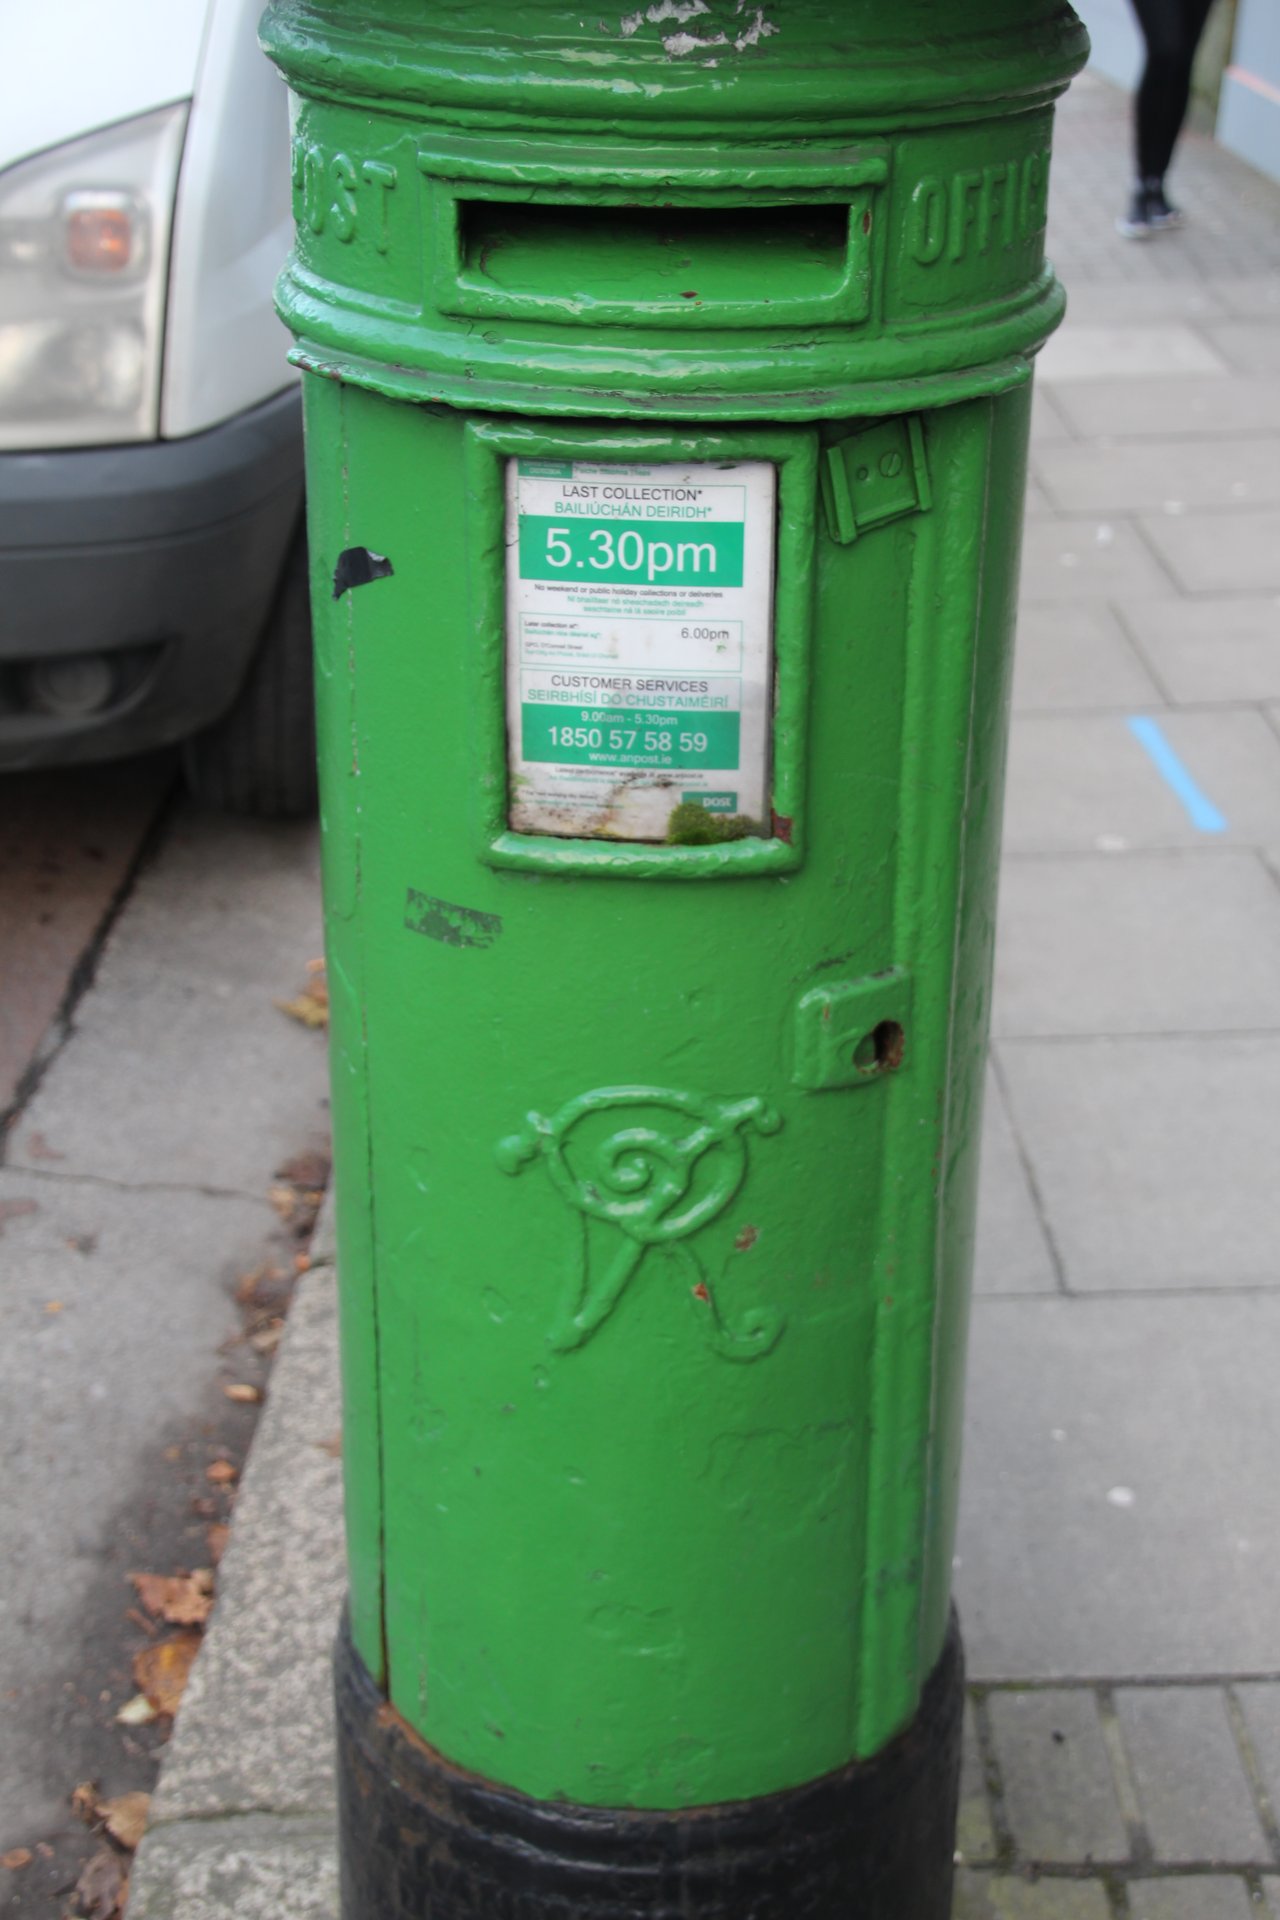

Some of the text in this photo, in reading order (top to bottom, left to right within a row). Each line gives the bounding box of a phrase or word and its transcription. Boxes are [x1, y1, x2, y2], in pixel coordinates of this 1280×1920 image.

[562, 485, 599, 498] LAST
[555, 500, 642, 517] BAILIÚCHÁN
[545, 527, 717, 581] 5.30pm
[534, 583, 545, 591] No
[547, 585, 578, 593] weekend
[589, 586, 610, 595] public
[612, 588, 637, 597] holiday
[639, 589, 677, 597] collections
[688, 590, 723, 598] deliveries
[681, 627, 730, 642] 6.00pm
[551, 675, 708, 693] CUSTOMER SERVICES
[581, 710, 625, 723] 9.00am
[634, 713, 678, 727] 5.30pm
[548, 726, 708, 753] 1850 57 58 59
[588, 752, 672, 765] www.anpost.ie
